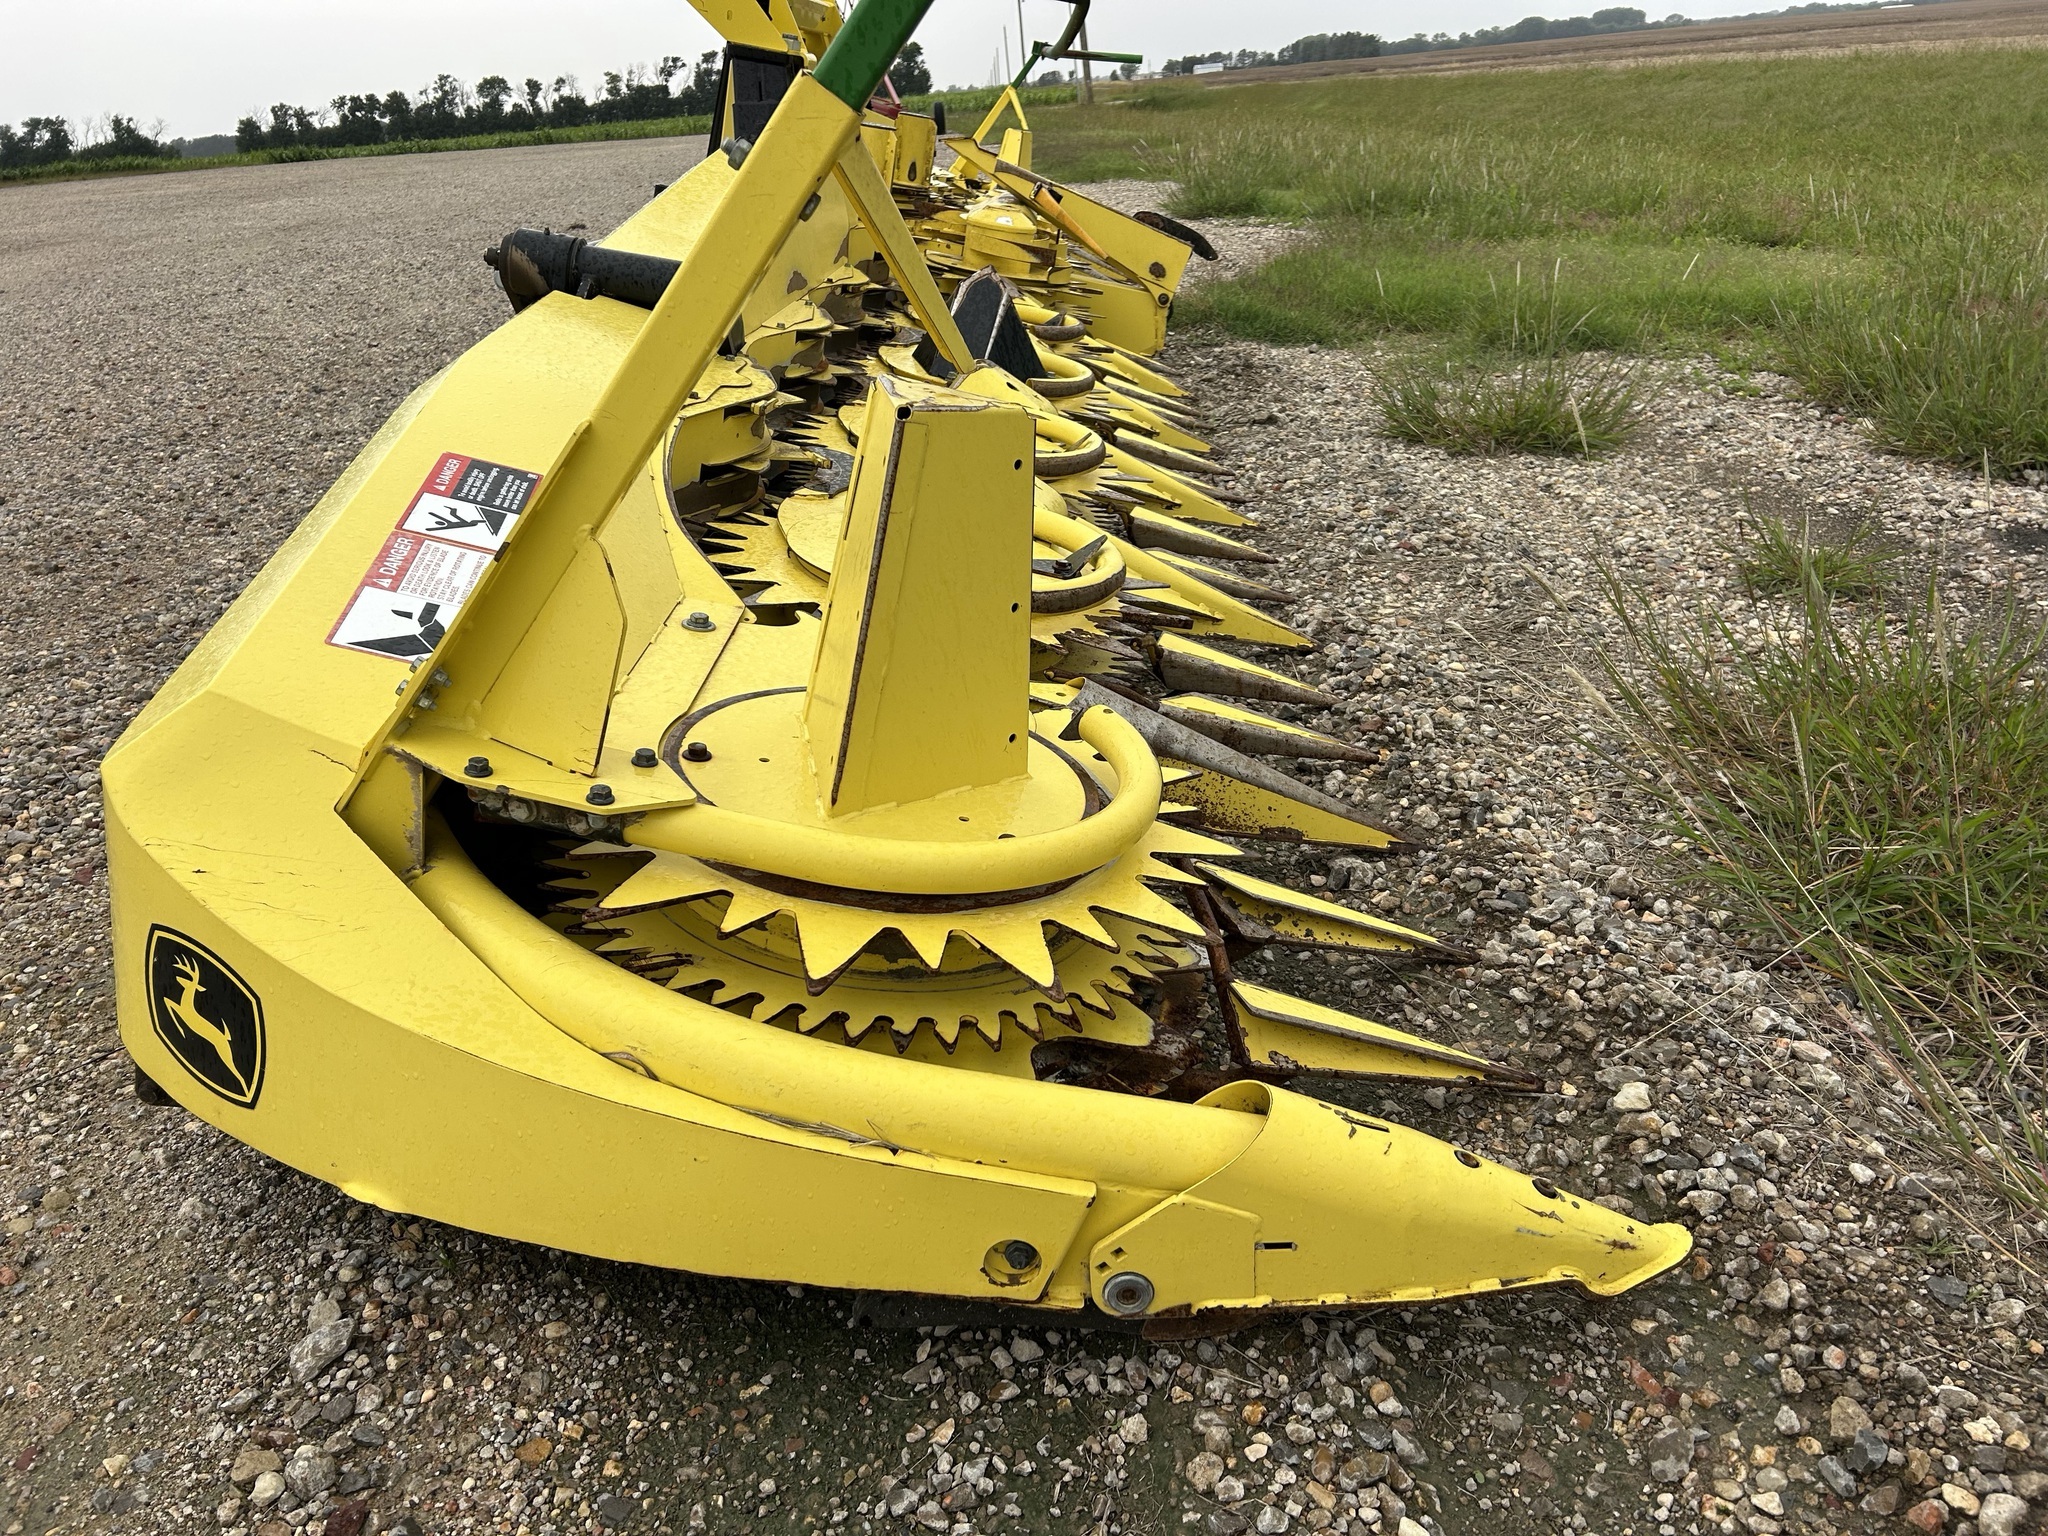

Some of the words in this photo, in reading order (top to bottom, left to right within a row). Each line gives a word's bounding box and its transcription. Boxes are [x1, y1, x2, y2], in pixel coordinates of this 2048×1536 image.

[436, 458, 462, 485] DANGER
[379, 536, 415, 576] DANGER
[404, 573, 417, 586] AVOID
[411, 556, 426, 573] SERIOUS
[420, 543, 433, 557] INJURY
[436, 549, 449, 562] BLADE
[451, 551, 468, 570] ROTATING
[413, 574, 426, 587] DEATH
[421, 563, 432, 574] LOOK
[428, 546, 441, 560] LISTEN
[468, 561, 486, 580] CONTINUE
[423, 568, 440, 587] EVIDENCE
[441, 576, 456, 589] CLEAR
[464, 580, 476, 589] CAN
[418, 587, 429, 596] FOR
[436, 589, 449, 600] STAY
